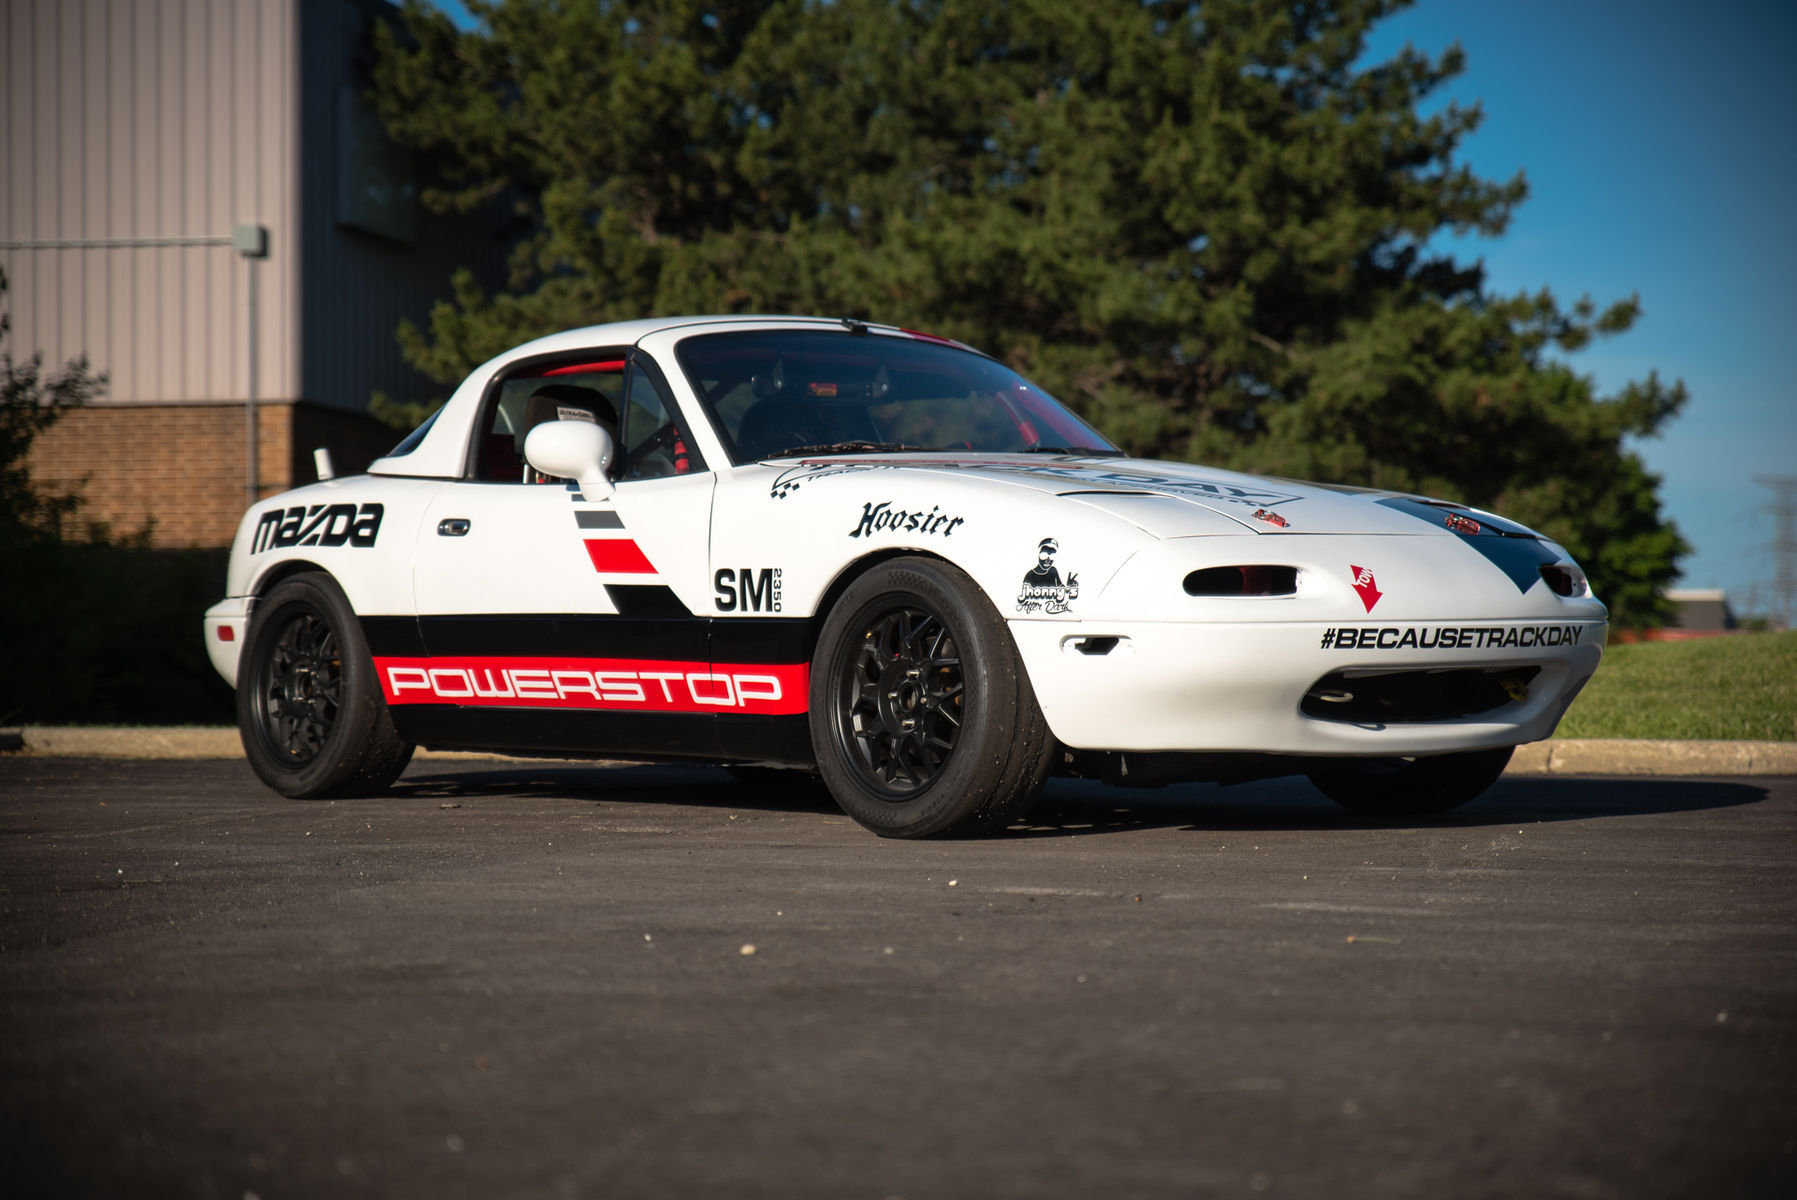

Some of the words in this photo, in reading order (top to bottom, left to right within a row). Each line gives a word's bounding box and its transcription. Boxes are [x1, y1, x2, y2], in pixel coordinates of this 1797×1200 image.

[847, 500, 965, 539] Hoosier
[714, 567, 773, 613] SM
[773, 567, 783, 613] 2350
[1015, 600, 1043, 615] After
[1044, 600, 1074, 615] Dark
[1320, 625, 1583, 650] #BECAUSETRACKDAY
[386, 666, 783, 707] POWERSTOP
